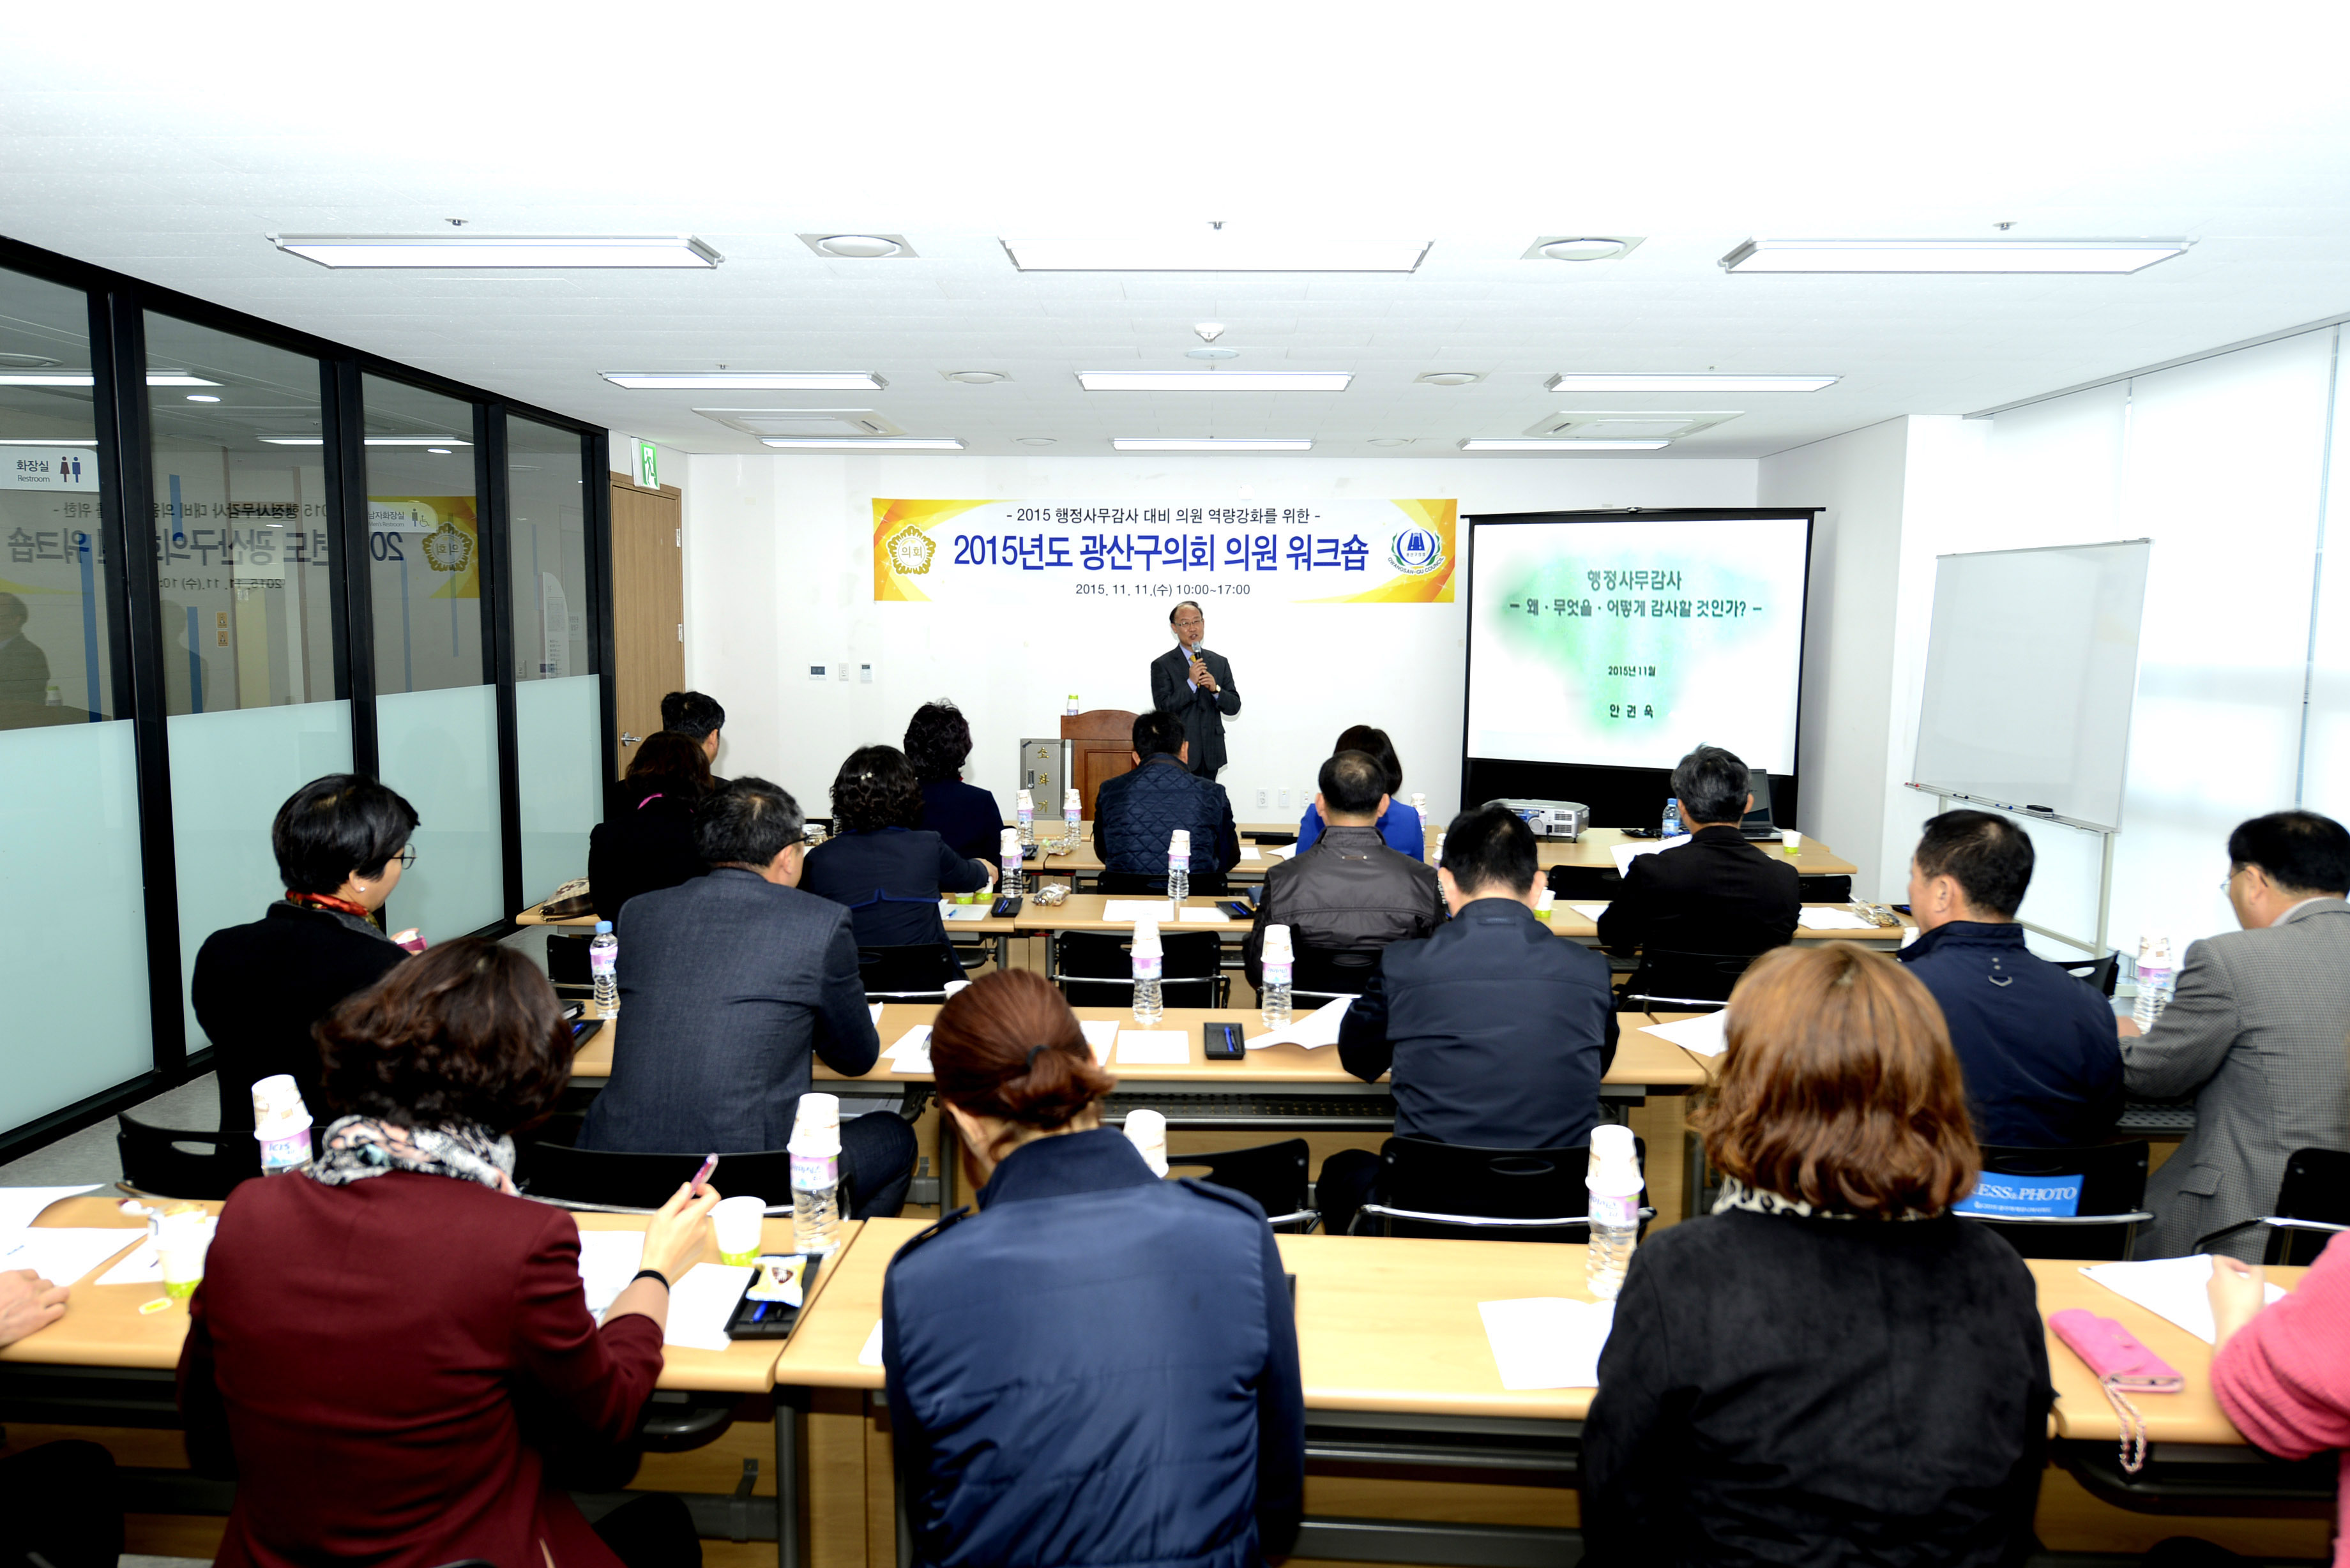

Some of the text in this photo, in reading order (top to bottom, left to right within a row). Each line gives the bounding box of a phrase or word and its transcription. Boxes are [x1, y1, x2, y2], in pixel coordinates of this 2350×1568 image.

[17, 460, 49, 472] 화장실
[17, 474, 50, 483] Restroom
[368, 511, 404, 520] 남자화장실
[1017, 508, 1050, 521] 2015
[1056, 508, 1139, 524] 행정사무감사
[1144, 508, 1170, 524] 대비
[1176, 508, 1202, 524] 의원
[1208, 508, 1278, 524] 역량강화를
[1282, 508, 1310, 524] 위한
[902, 546, 922, 558] 의회
[954, 534, 1369, 571] 2015년도 광산구의회 의원 워크숍
[1388, 557, 1444, 575] GWANGSAN-GU COUNCIL
[1588, 569, 1681, 591] 행정사무감사
[1075, 584, 1251, 597] 2015. 11. 11.(수) 10:00~17:00
[1527, 598, 1539, 616] 왜
[1554, 599, 1592, 617] 무엇을
[1607, 599, 1646, 618] 어떻게
[1651, 599, 1692, 617] 감사할
[1697, 599, 1747, 617] 것인가?
[1610, 704, 1620, 718] 안
[1972, 1183, 2077, 1201] ESS&PHOTO
